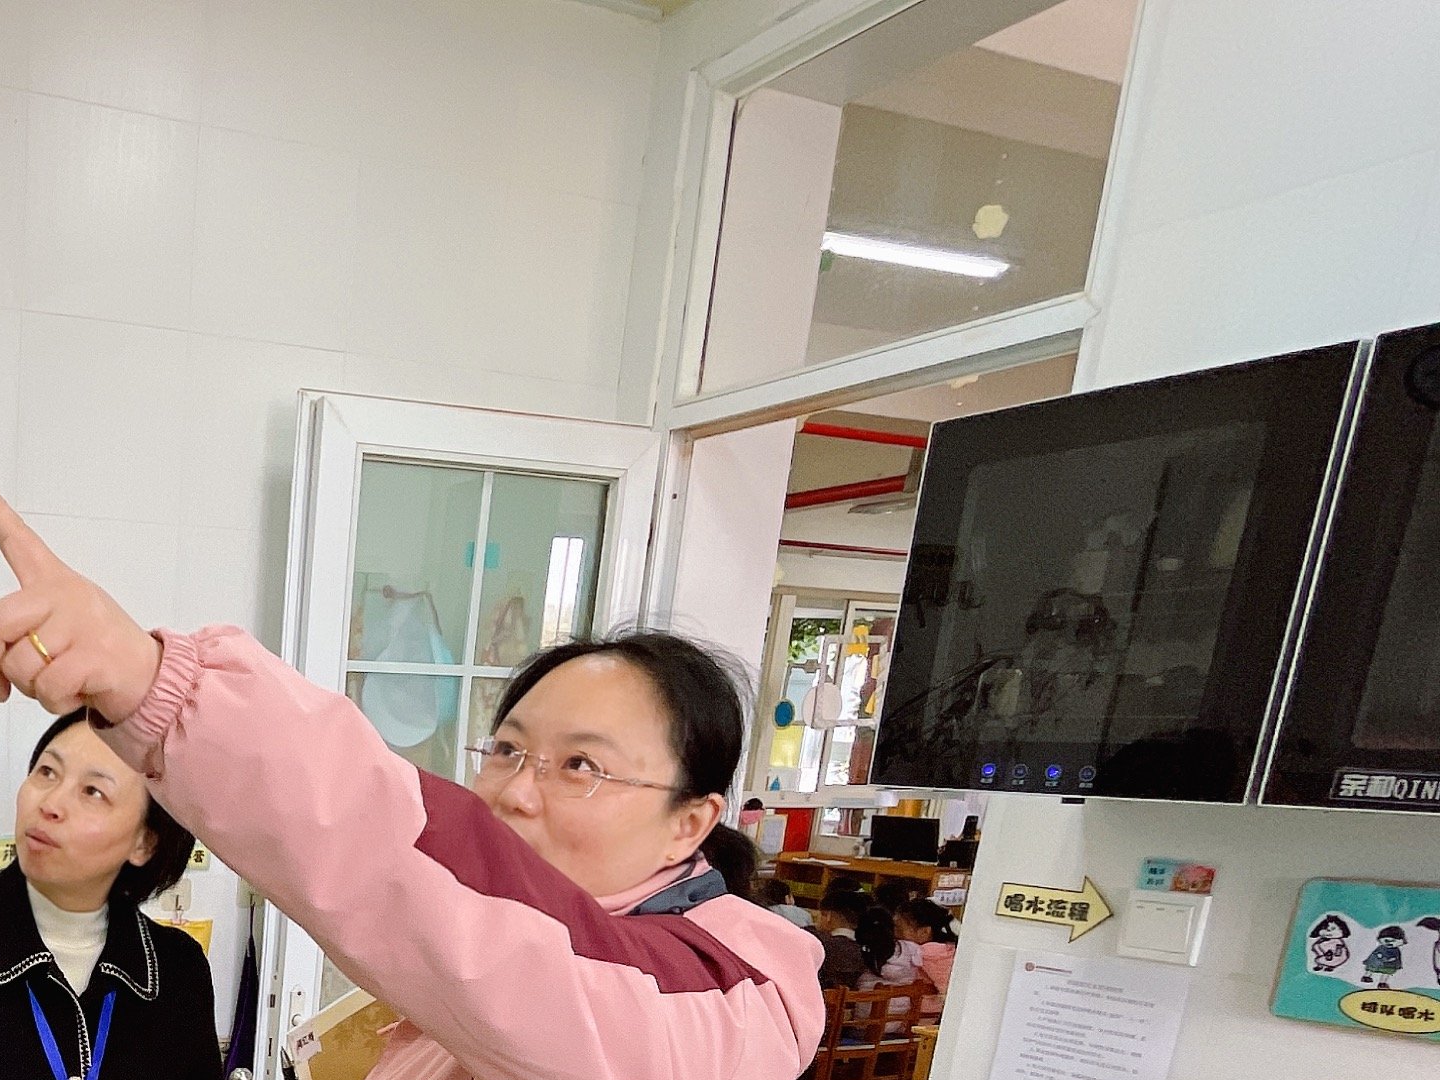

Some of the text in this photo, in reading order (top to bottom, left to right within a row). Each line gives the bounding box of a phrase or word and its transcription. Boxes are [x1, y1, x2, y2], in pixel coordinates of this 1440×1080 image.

[1004, 893, 1090, 922] 喝水流程
[1360, 1001, 1436, 1022] 排队喝水
